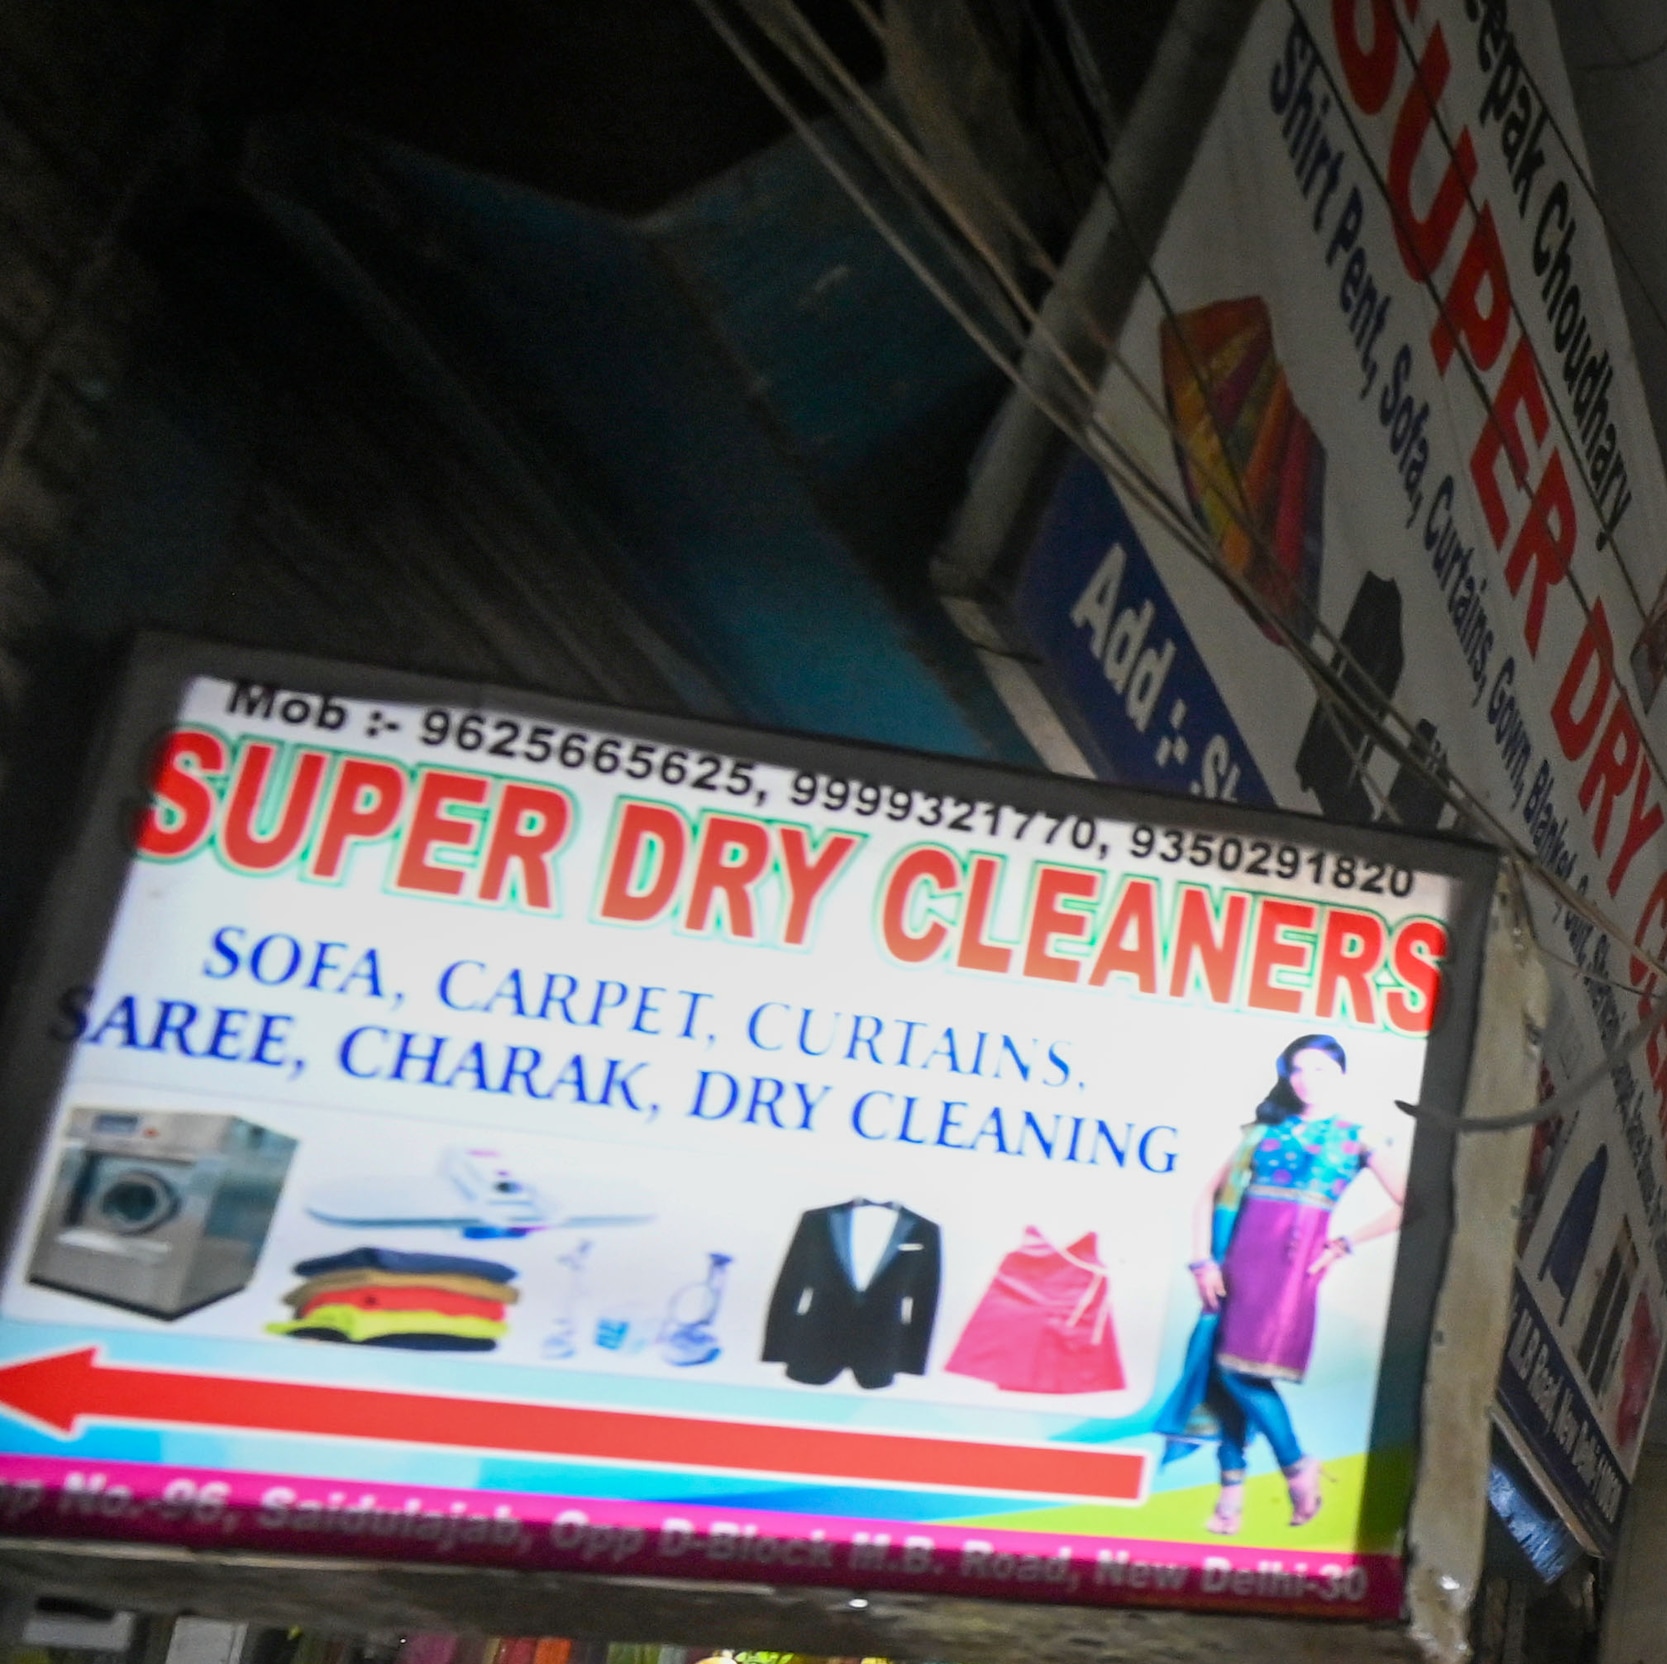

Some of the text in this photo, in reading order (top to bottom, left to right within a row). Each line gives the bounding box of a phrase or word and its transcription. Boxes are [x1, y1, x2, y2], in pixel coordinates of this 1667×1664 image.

[1467, 0, 1632, 551] epak Choudhary
[1270, 34, 1346, 231] Shirt
[1325, 186, 1391, 400] Pent,
[1378, 342, 1431, 530] Sofa,
[1422, 475, 1493, 707] Curtains,
[1490, 656, 1532, 817] Gown,
[1331, 0, 1576, 659] SUPER
[1551, 597, 1663, 898] DRY
[1070, 542, 1178, 731] Add
[132, 727, 1449, 1035] SUPER DRY CLEANERS
[226, 681, 347, 735] Mob
[420, 708, 768, 807] 9625665625,
[790, 772, 1109, 860] 9999321770,
[1130, 826, 1415, 899] 9350291820
[50, 987, 1180, 1175] SAREE, CHARAK, DRY CLEANING
[203, 925, 1086, 1093] SOFA, CARPET, CURTAINS,
[550, 1509, 646, 1563] Opp
[659, 1519, 833, 1573] D-Block
[959, 1541, 1083, 1588] Road,
[1094, 1549, 1187, 1592] New
[1202, 1556, 1368, 1601] Delhi-30
